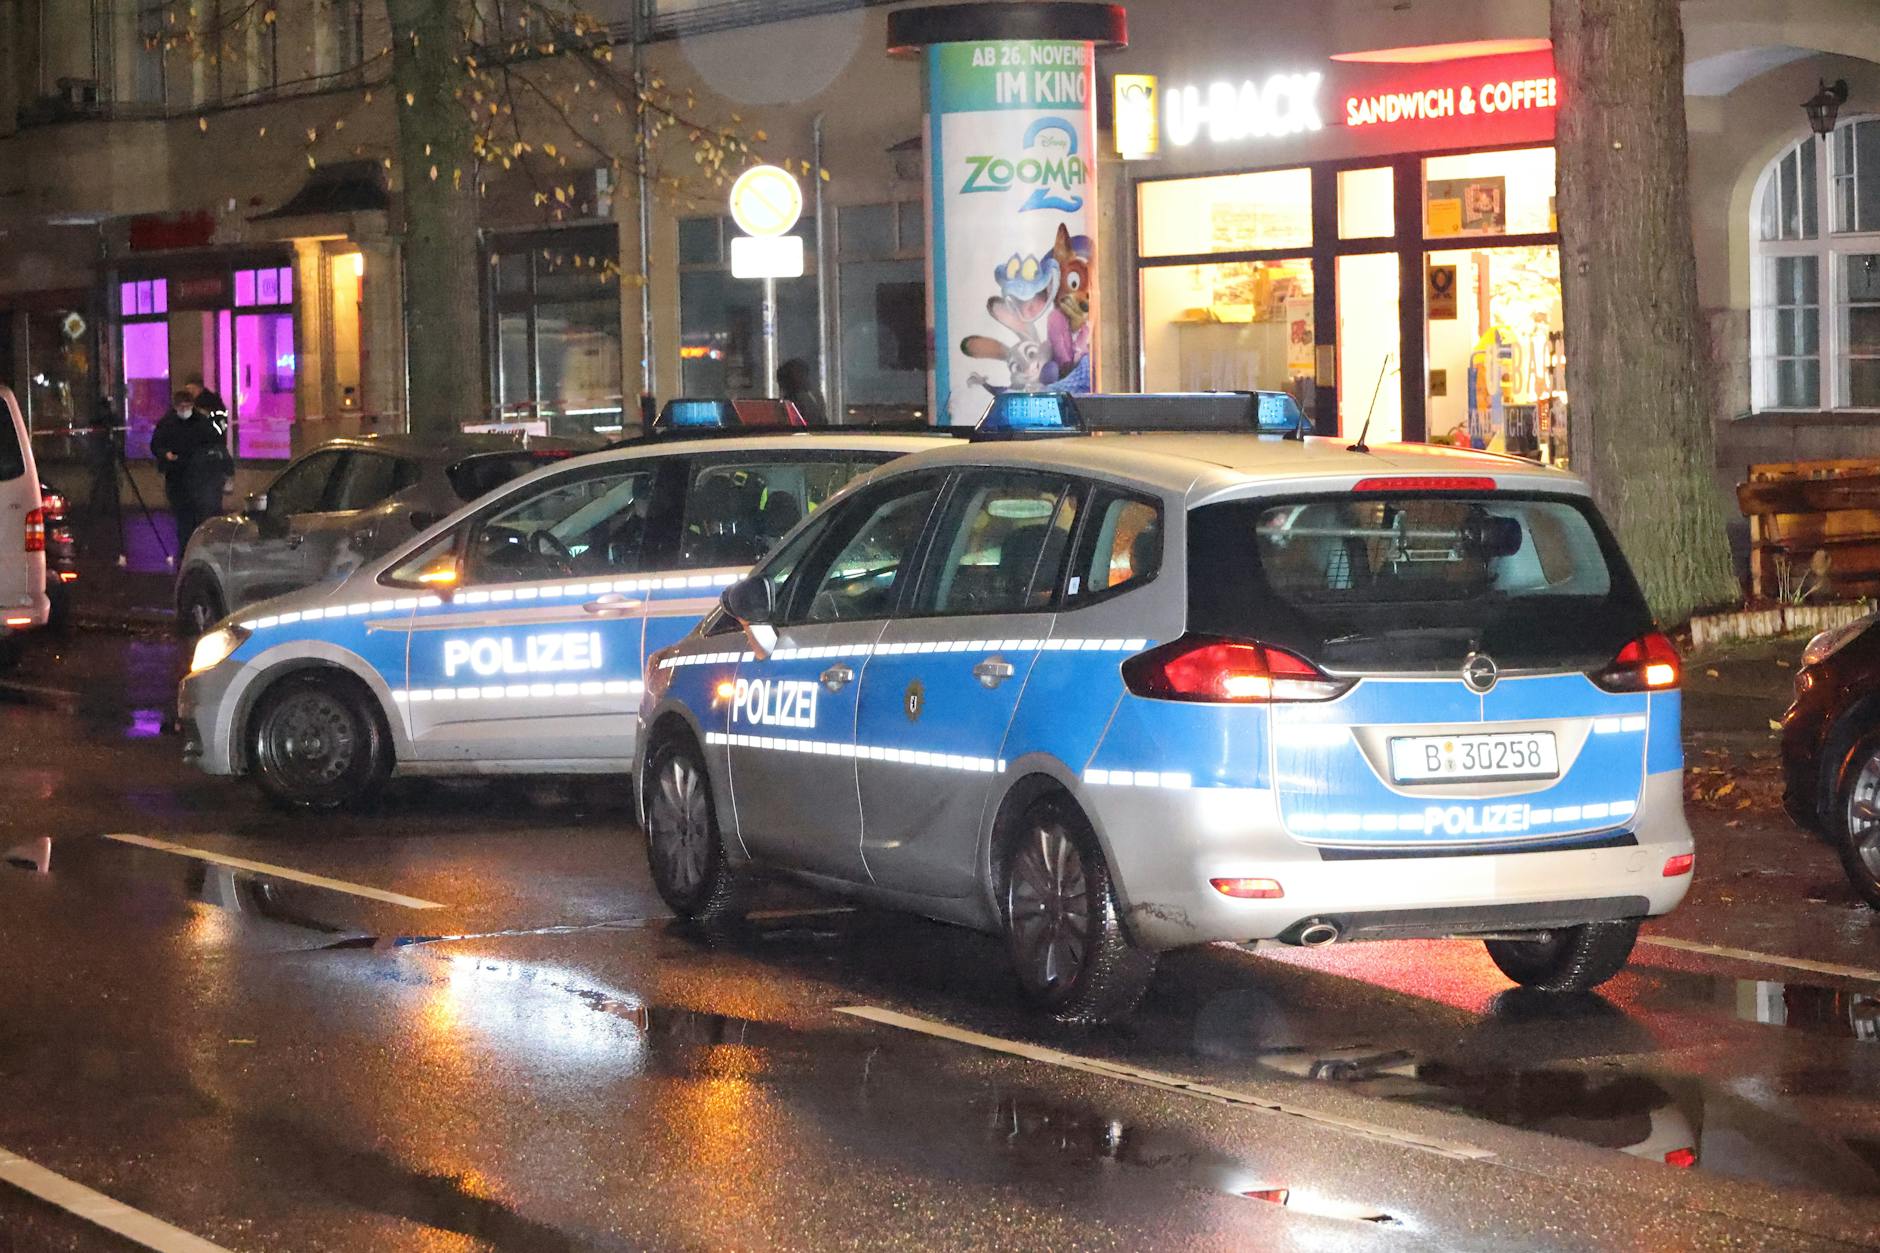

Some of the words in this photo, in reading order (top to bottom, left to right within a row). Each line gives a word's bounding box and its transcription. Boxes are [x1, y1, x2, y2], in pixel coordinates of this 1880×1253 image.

[972, 47, 996, 66] AB
[995, 72, 1027, 103] IM
[1034, 71, 1087, 103] KINO
[1347, 87, 1454, 126] SANDWICH
[1459, 86, 1476, 115] &
[444, 632, 602, 677] POLIZEI
[733, 679, 819, 728] POLIZEI
[1425, 744, 1441, 771] B
[1461, 740, 1541, 769] 30258
[1424, 803, 1530, 835] POLIZEI
